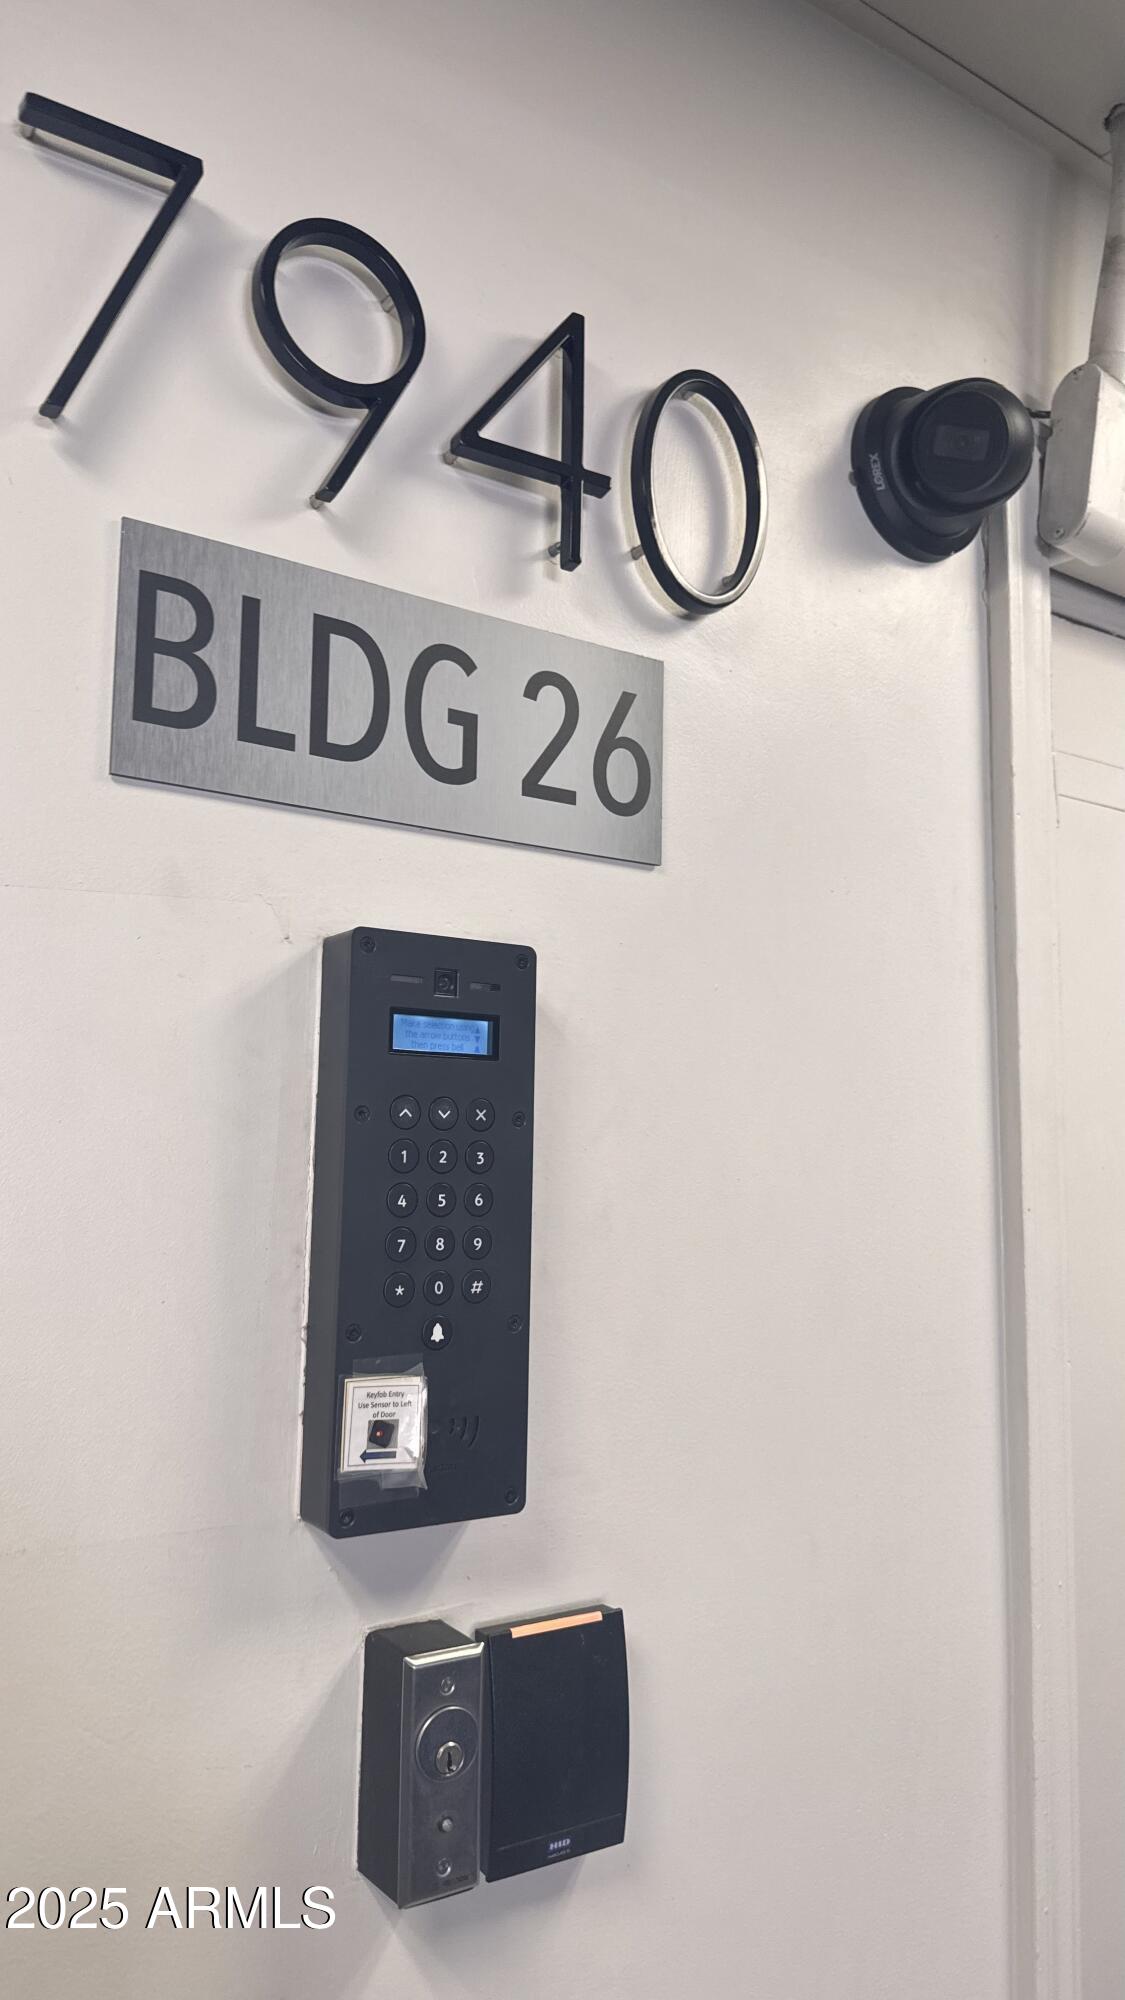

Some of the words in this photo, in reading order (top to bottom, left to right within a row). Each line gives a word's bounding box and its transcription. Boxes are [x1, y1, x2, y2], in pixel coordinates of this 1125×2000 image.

[19, 91, 768, 616] 7940
[869, 452, 886, 490] LOREX
[132, 569, 479, 786] BLDG
[521, 670, 651, 817] 26
[401, 1150, 407, 1163] 1
[439, 1150, 447, 1163] 2
[476, 1152, 485, 1165] 3
[397, 1194, 407, 1208] 4
[437, 1193, 446, 1207] 5
[474, 1193, 483, 1207] 6
[397, 1239, 406, 1253] 7
[435, 1237, 445, 1251] 8
[473, 1237, 482, 1251] 9
[434, 1281, 443, 1295] 0
[470, 1280, 484, 1294] #
[366, 1391, 387, 1399] Keyfob
[388, 1390, 405, 1398] Entry
[370, 1401, 391, 1409] Sensor
[549, 1838, 571, 1850] HID
